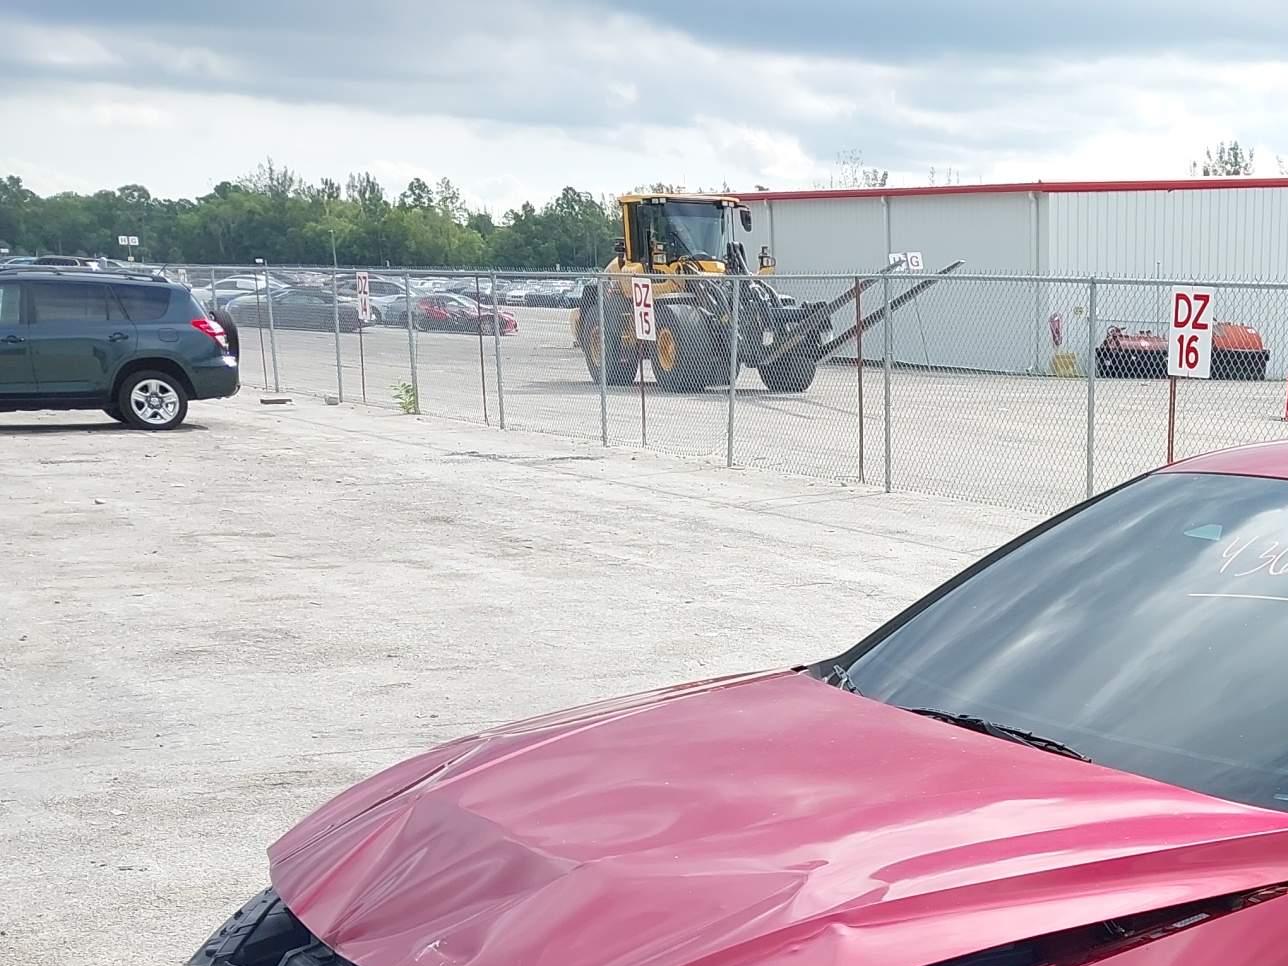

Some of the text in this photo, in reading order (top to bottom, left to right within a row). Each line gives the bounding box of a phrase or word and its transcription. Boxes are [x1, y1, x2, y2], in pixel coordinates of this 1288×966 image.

[910, 255, 920, 267] G
[358, 276, 368, 294] DZ
[634, 283, 651, 308] DZ
[639, 311, 651, 335] 15
[1174, 293, 1210, 330] DZ
[1177, 334, 1199, 369] 16
